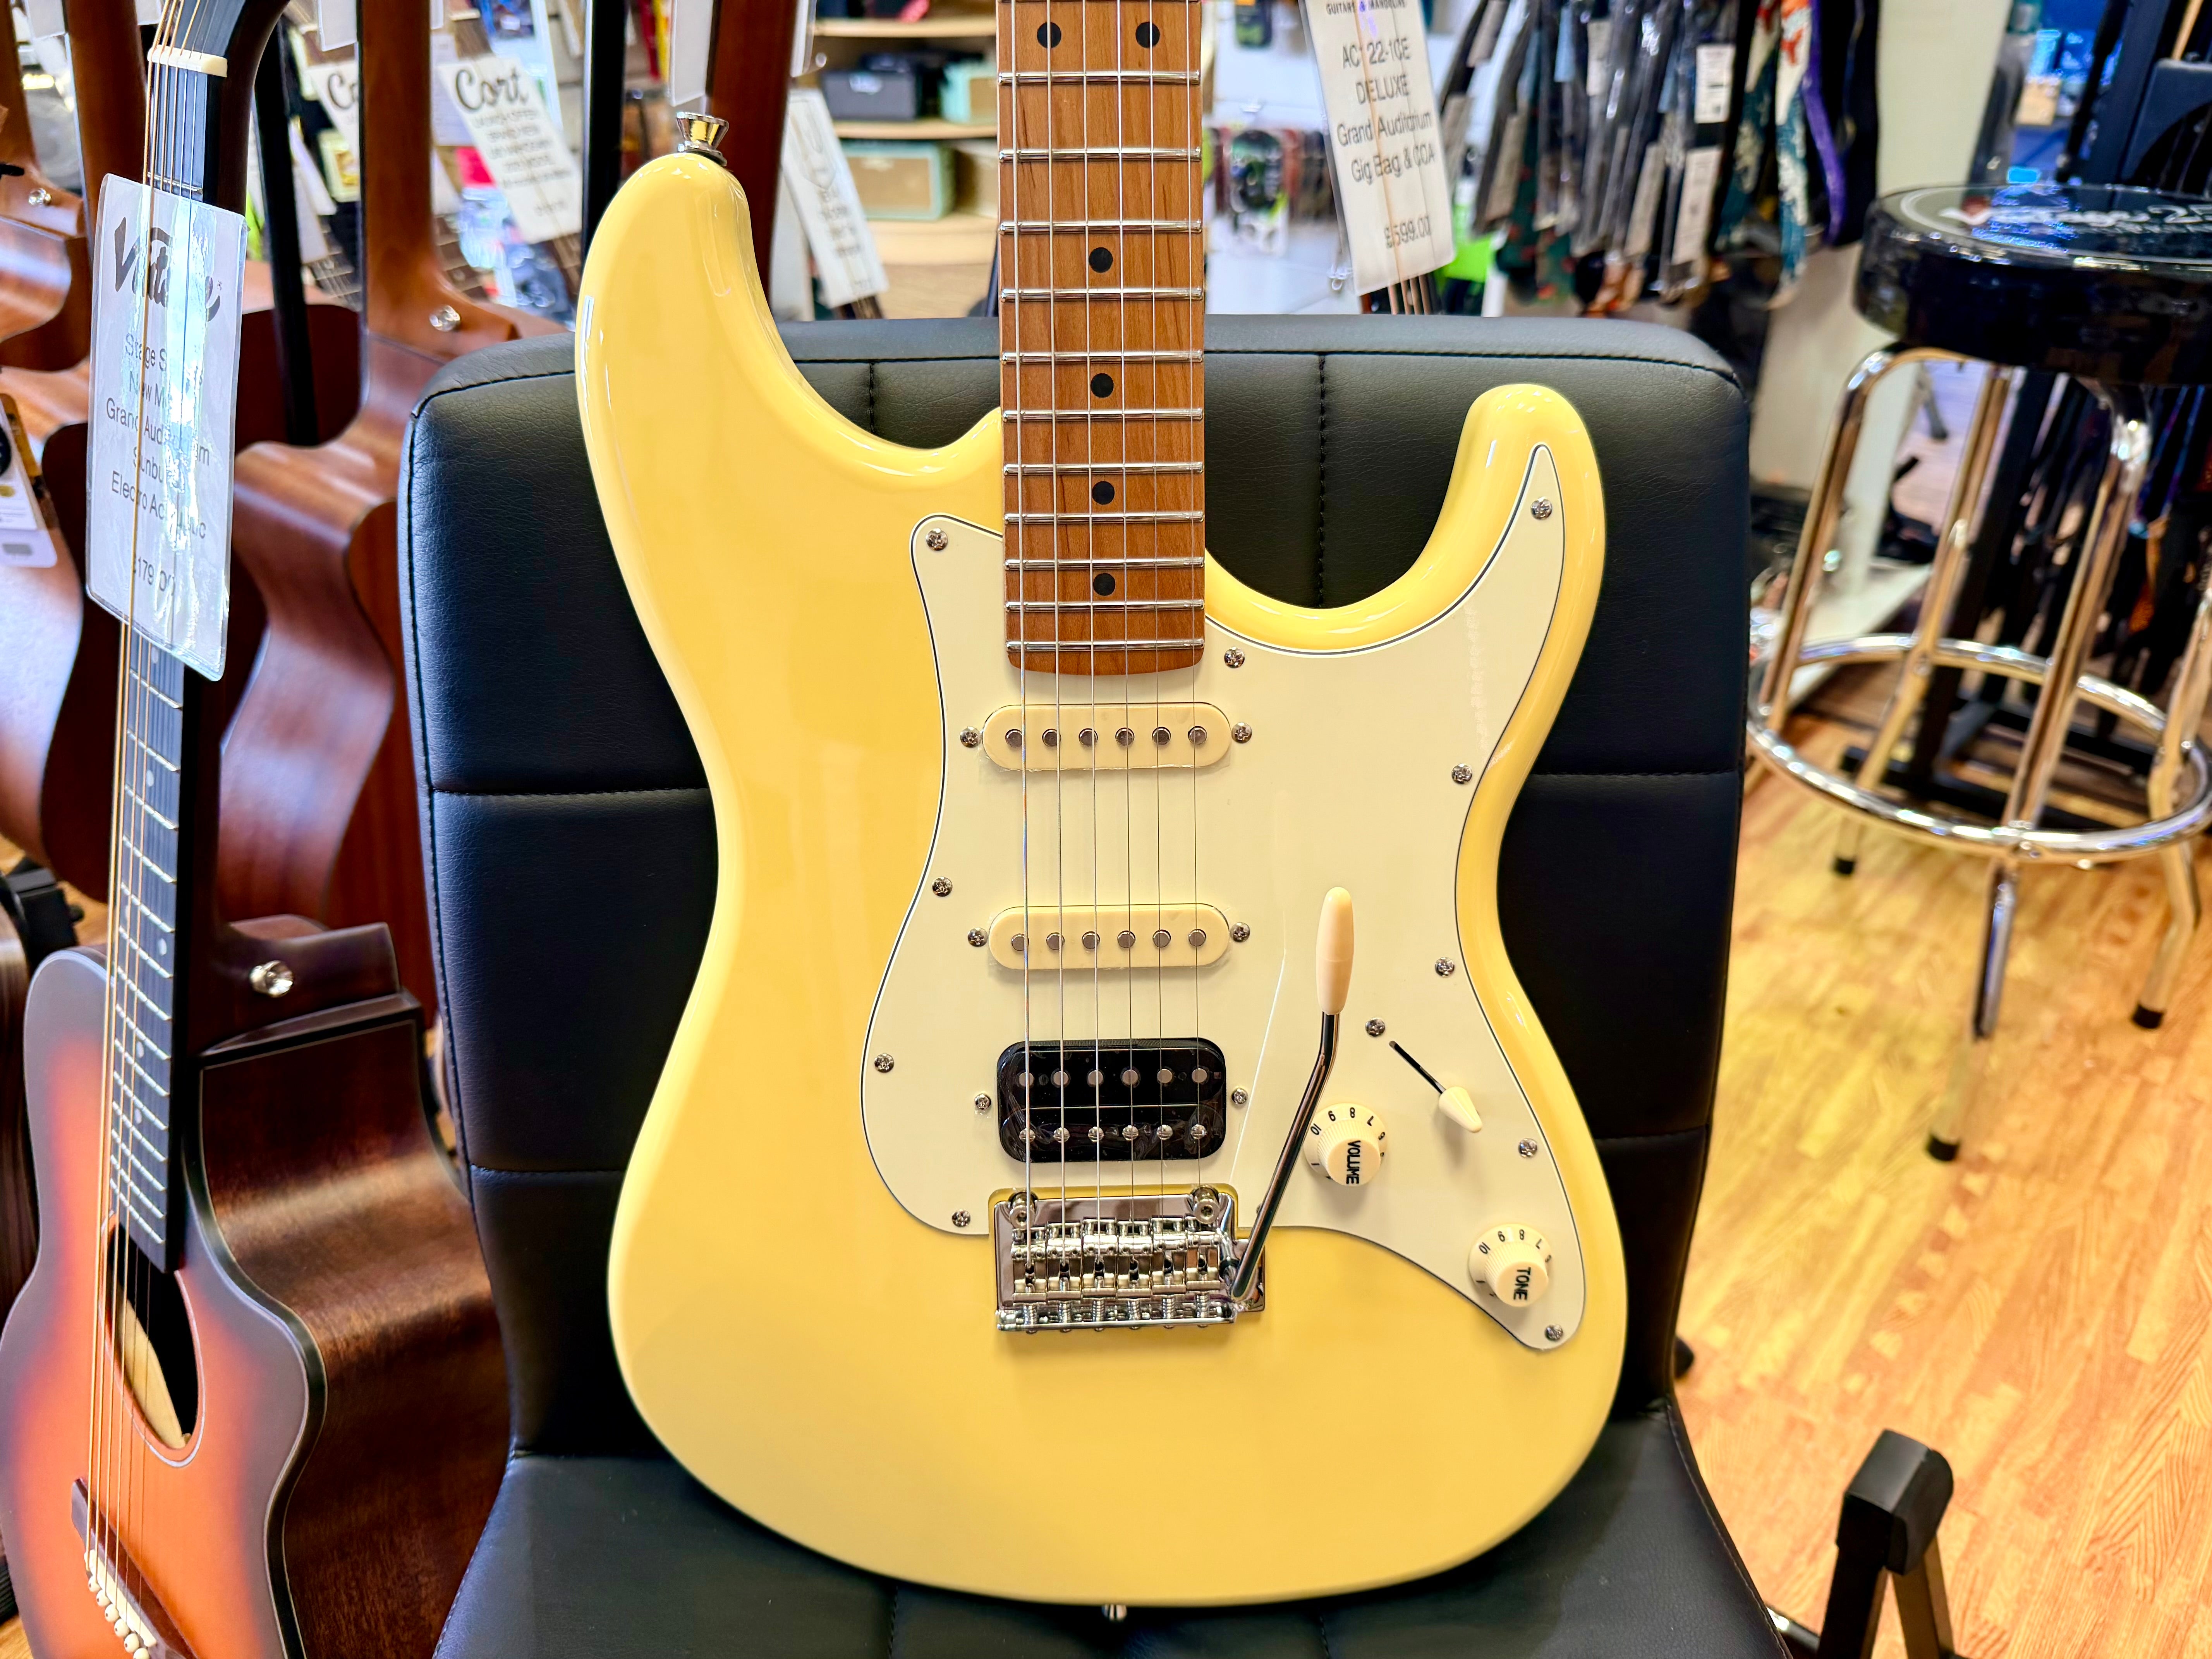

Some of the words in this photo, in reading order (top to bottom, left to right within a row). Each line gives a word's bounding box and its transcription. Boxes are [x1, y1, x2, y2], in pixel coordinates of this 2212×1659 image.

[1342, 38, 1411, 69] AC22-1CE
[1356, 74, 1409, 105] DELUXE
[1337, 118, 1373, 146] Grand
[1377, 112, 1432, 137] Auditorium
[1351, 158, 1373, 185] Gig
[1373, 154, 1402, 177] Bag
[1403, 147, 1412, 170] &
[1310, 1123, 1322, 1135] 10
[1350, 1107, 1355, 1118] 8
[1367, 1115, 1374, 1127] 7
[1346, 1140, 1361, 1184] VOLUME
[1479, 1242, 1491, 1254] 10
[1519, 1229, 1525, 1240] 8
[1535, 1238, 1542, 1249] 7
[1513, 1266, 1531, 1300] TONE
